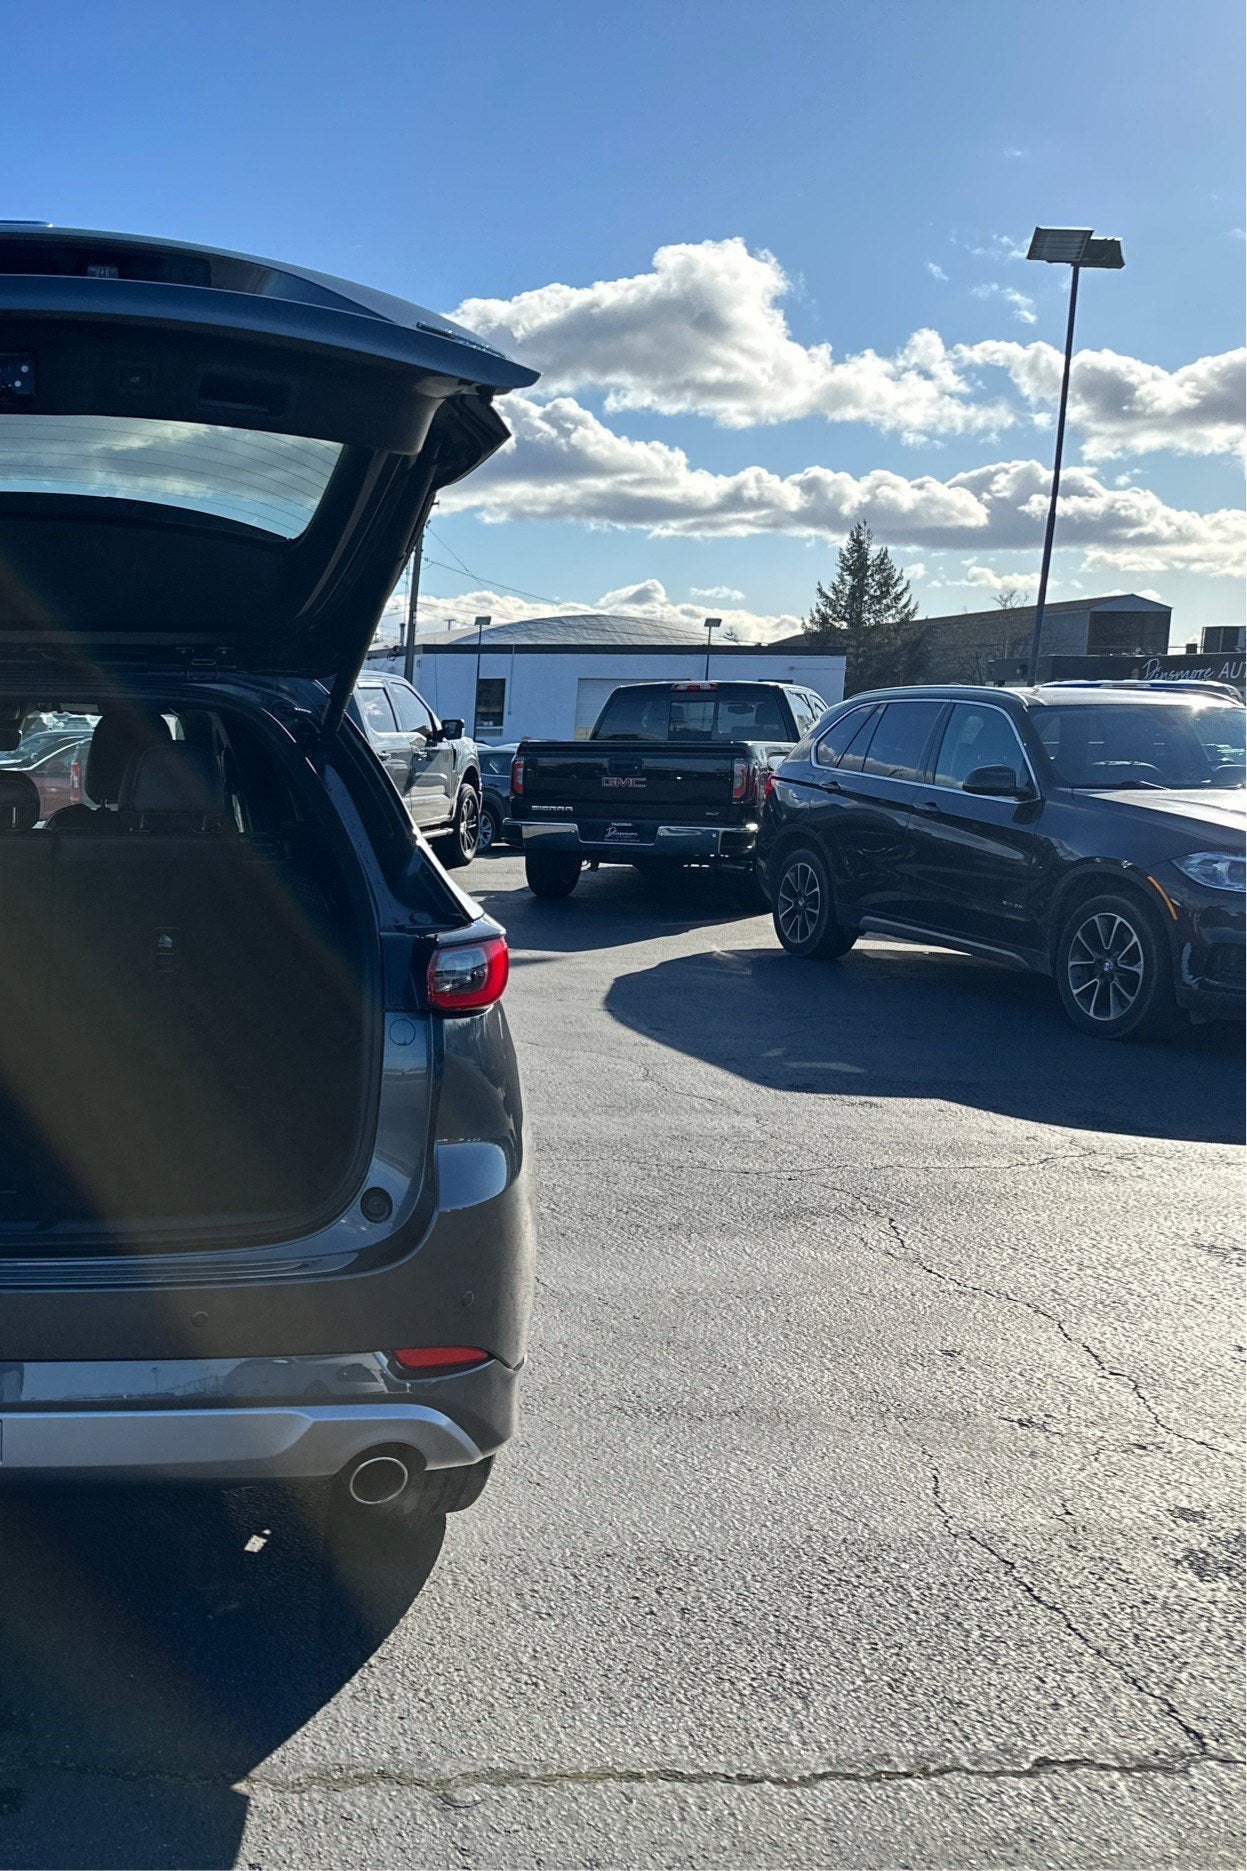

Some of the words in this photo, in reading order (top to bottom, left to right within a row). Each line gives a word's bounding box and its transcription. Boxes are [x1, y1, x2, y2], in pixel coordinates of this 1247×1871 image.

[1142, 658, 1216, 681] Dinsmore
[1218, 661, 1246, 679] AU
[601, 776, 647, 788] GMC
